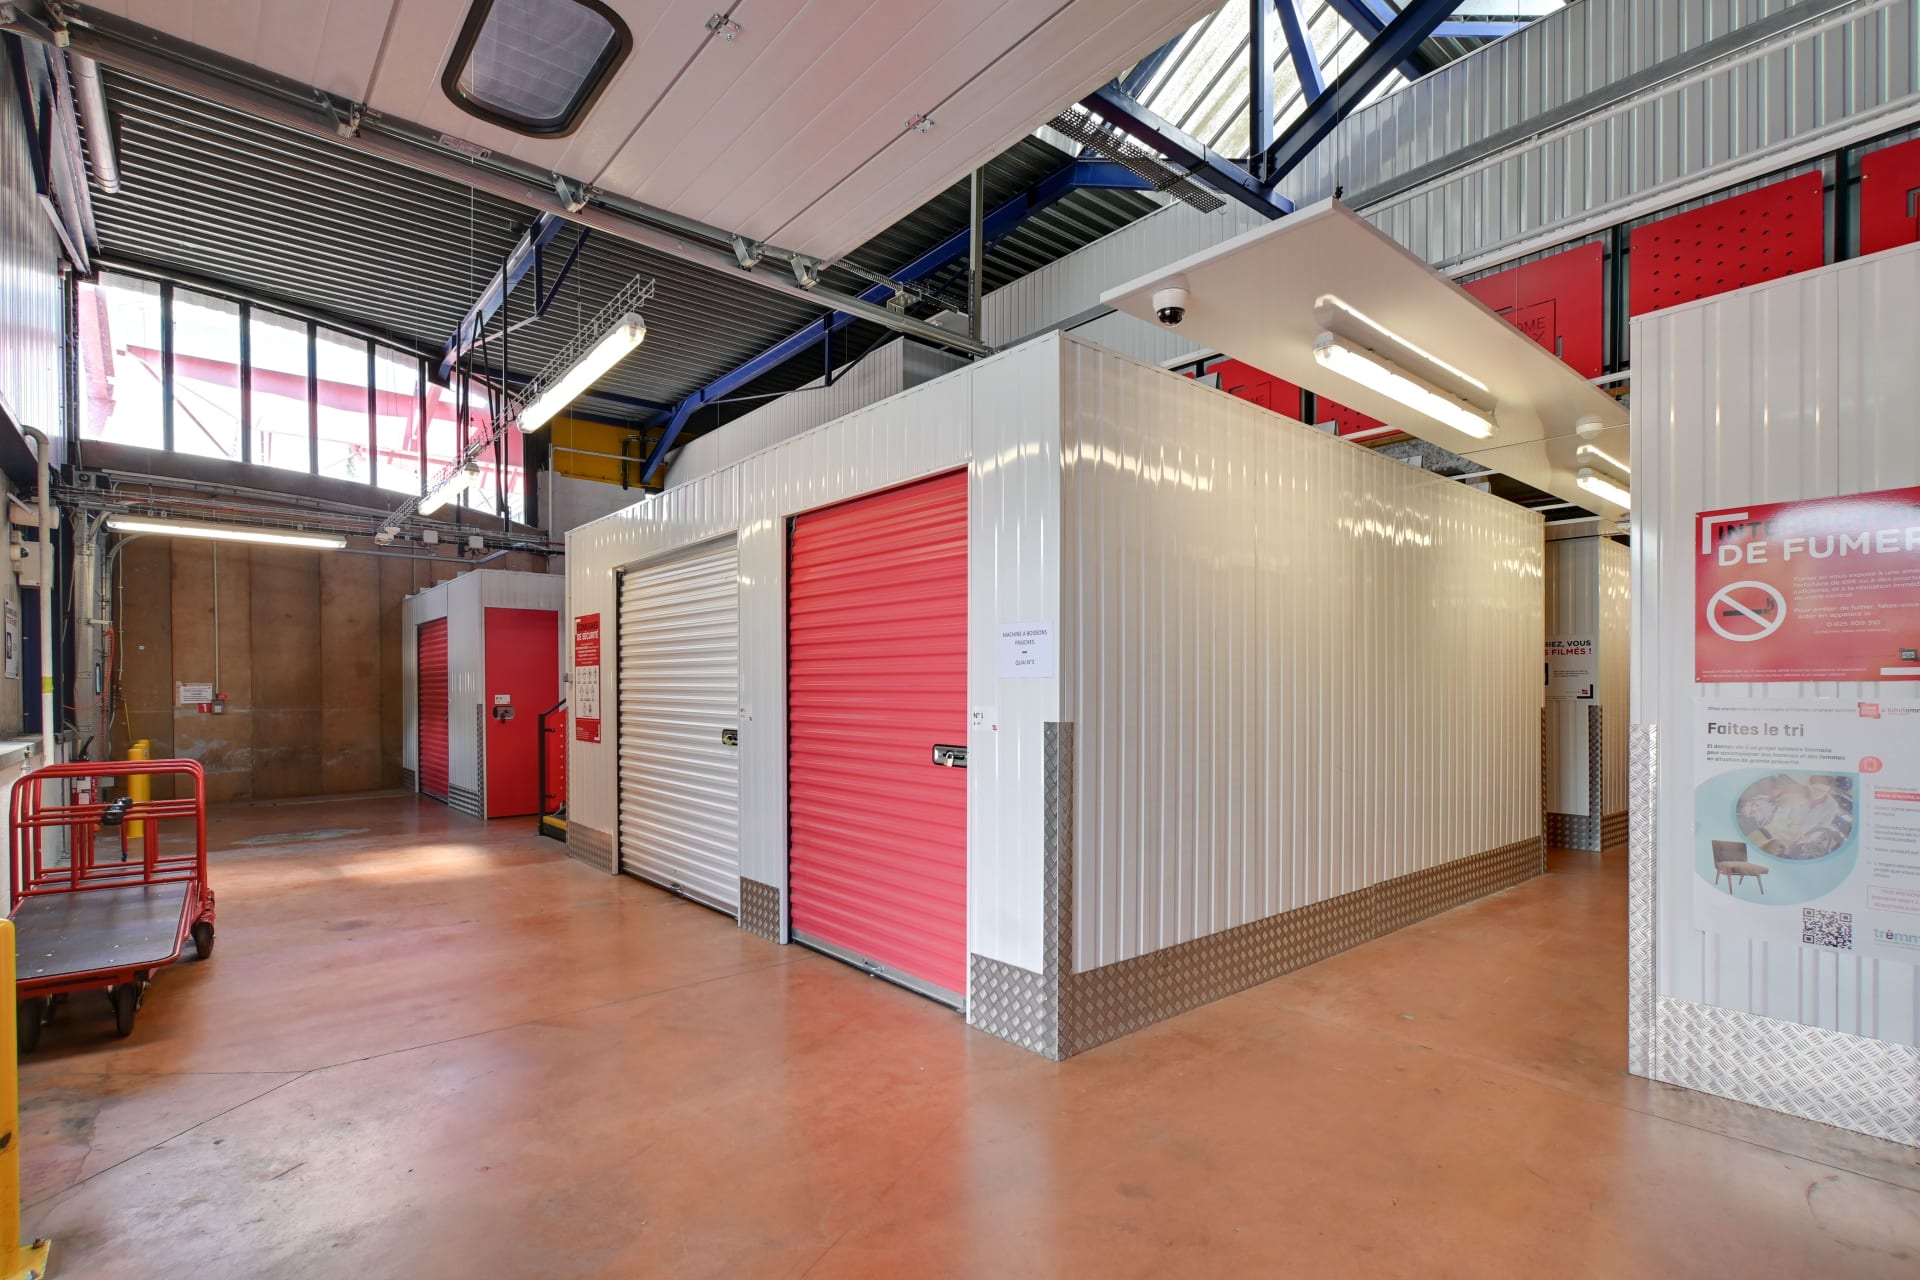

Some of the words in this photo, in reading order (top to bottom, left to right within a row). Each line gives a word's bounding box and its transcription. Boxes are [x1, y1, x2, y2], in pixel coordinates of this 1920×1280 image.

[1718, 541, 1768, 567] DE
[1552, 646, 1586, 656] FILMÉS
[1707, 722, 1760, 737] Faites
[1764, 722, 1780, 737] le
[1784, 723, 1805, 737] tri
